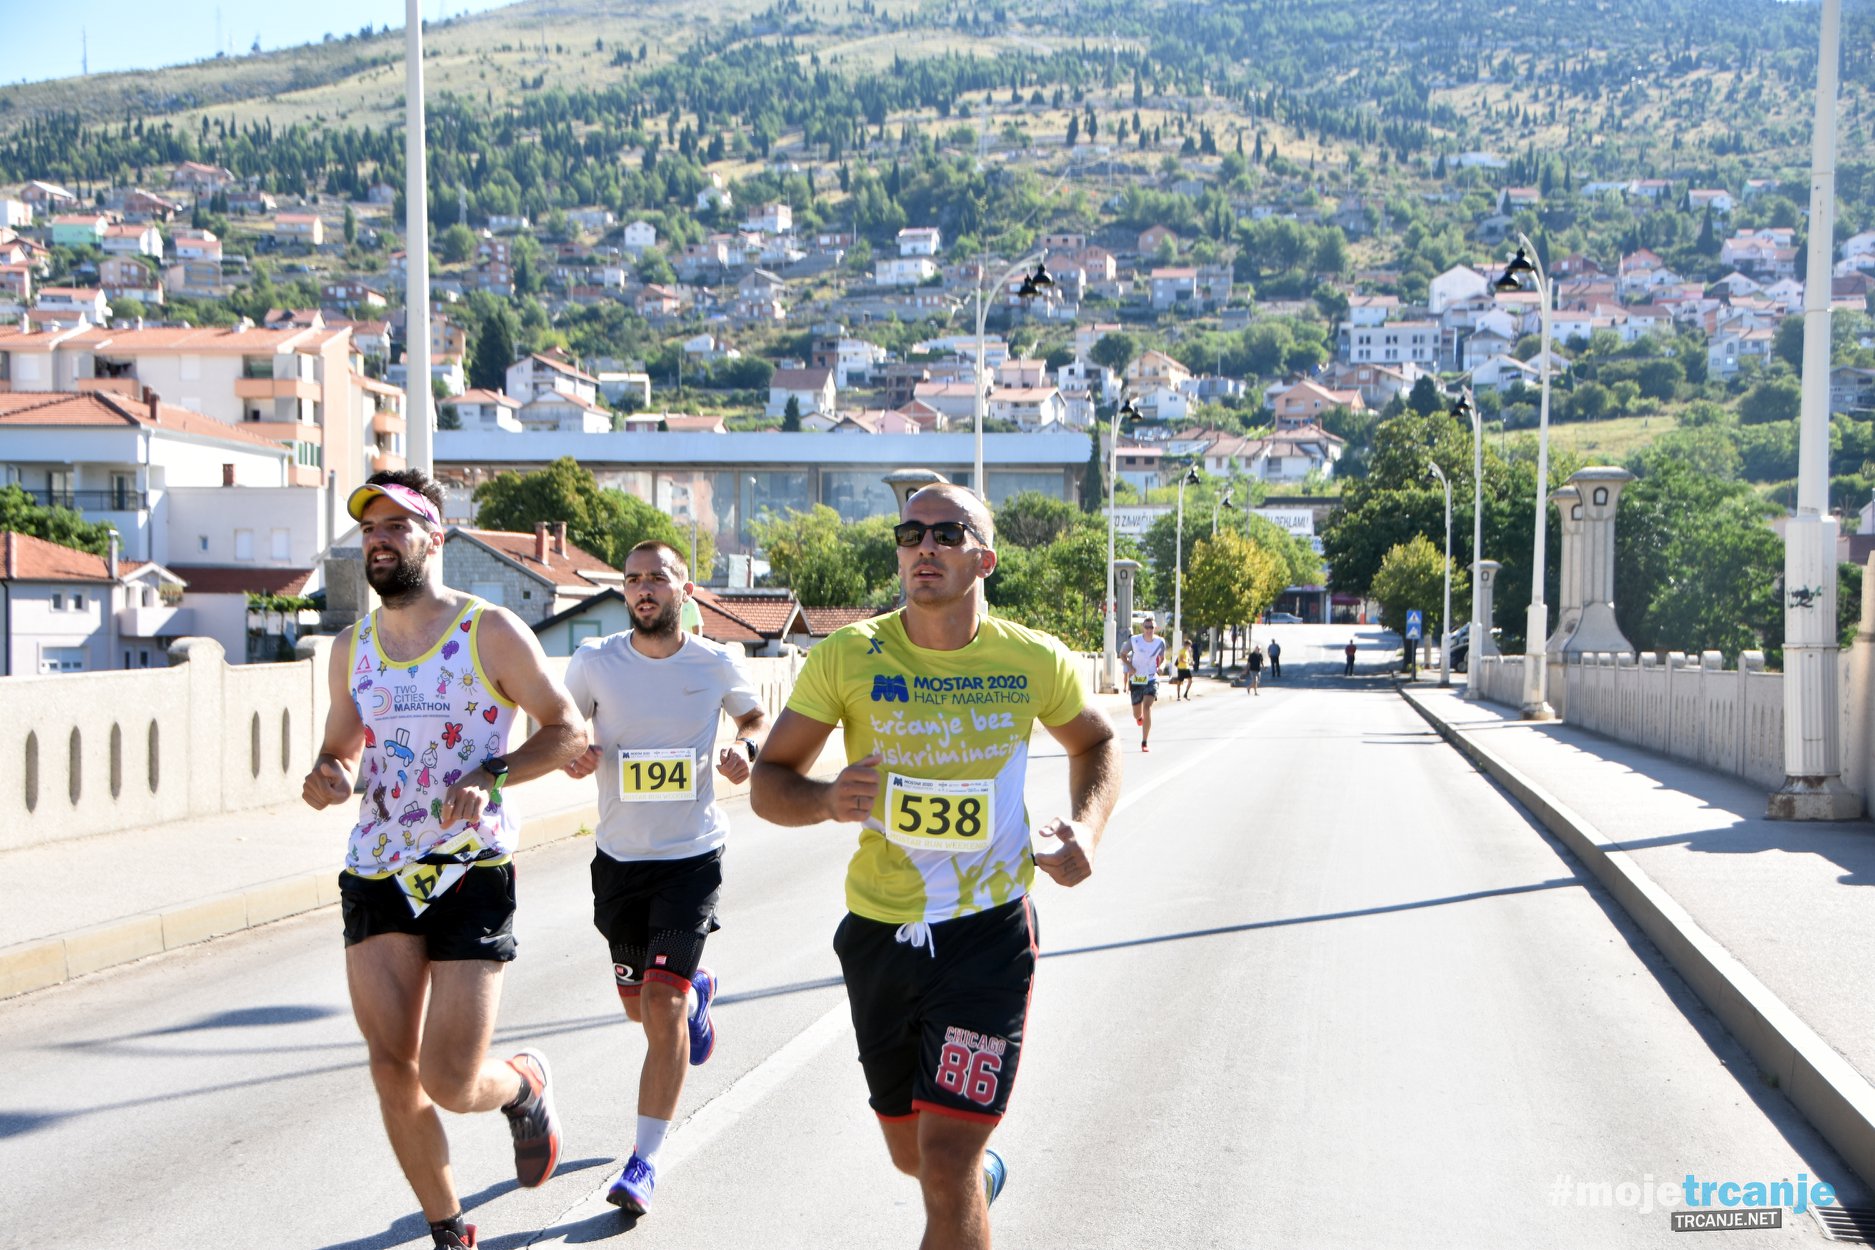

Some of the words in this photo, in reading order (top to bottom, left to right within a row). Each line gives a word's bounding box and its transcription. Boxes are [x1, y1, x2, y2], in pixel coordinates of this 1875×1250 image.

[394, 684, 417, 695] TWO
[913, 675, 983, 691] MOSTAR
[987, 674, 1028, 690] 2020
[394, 693, 425, 704] CITIES
[394, 702, 451, 712] MARATHON
[914, 691, 948, 705] HALF
[952, 690, 1030, 705] MARATHON
[870, 710, 963, 748] trčanje
[971, 707, 1014, 732] bez
[630, 761, 687, 791] 194
[898, 794, 982, 837] 538
[945, 1026, 1007, 1056] CHICAGO
[935, 1041, 1003, 1107] 86
